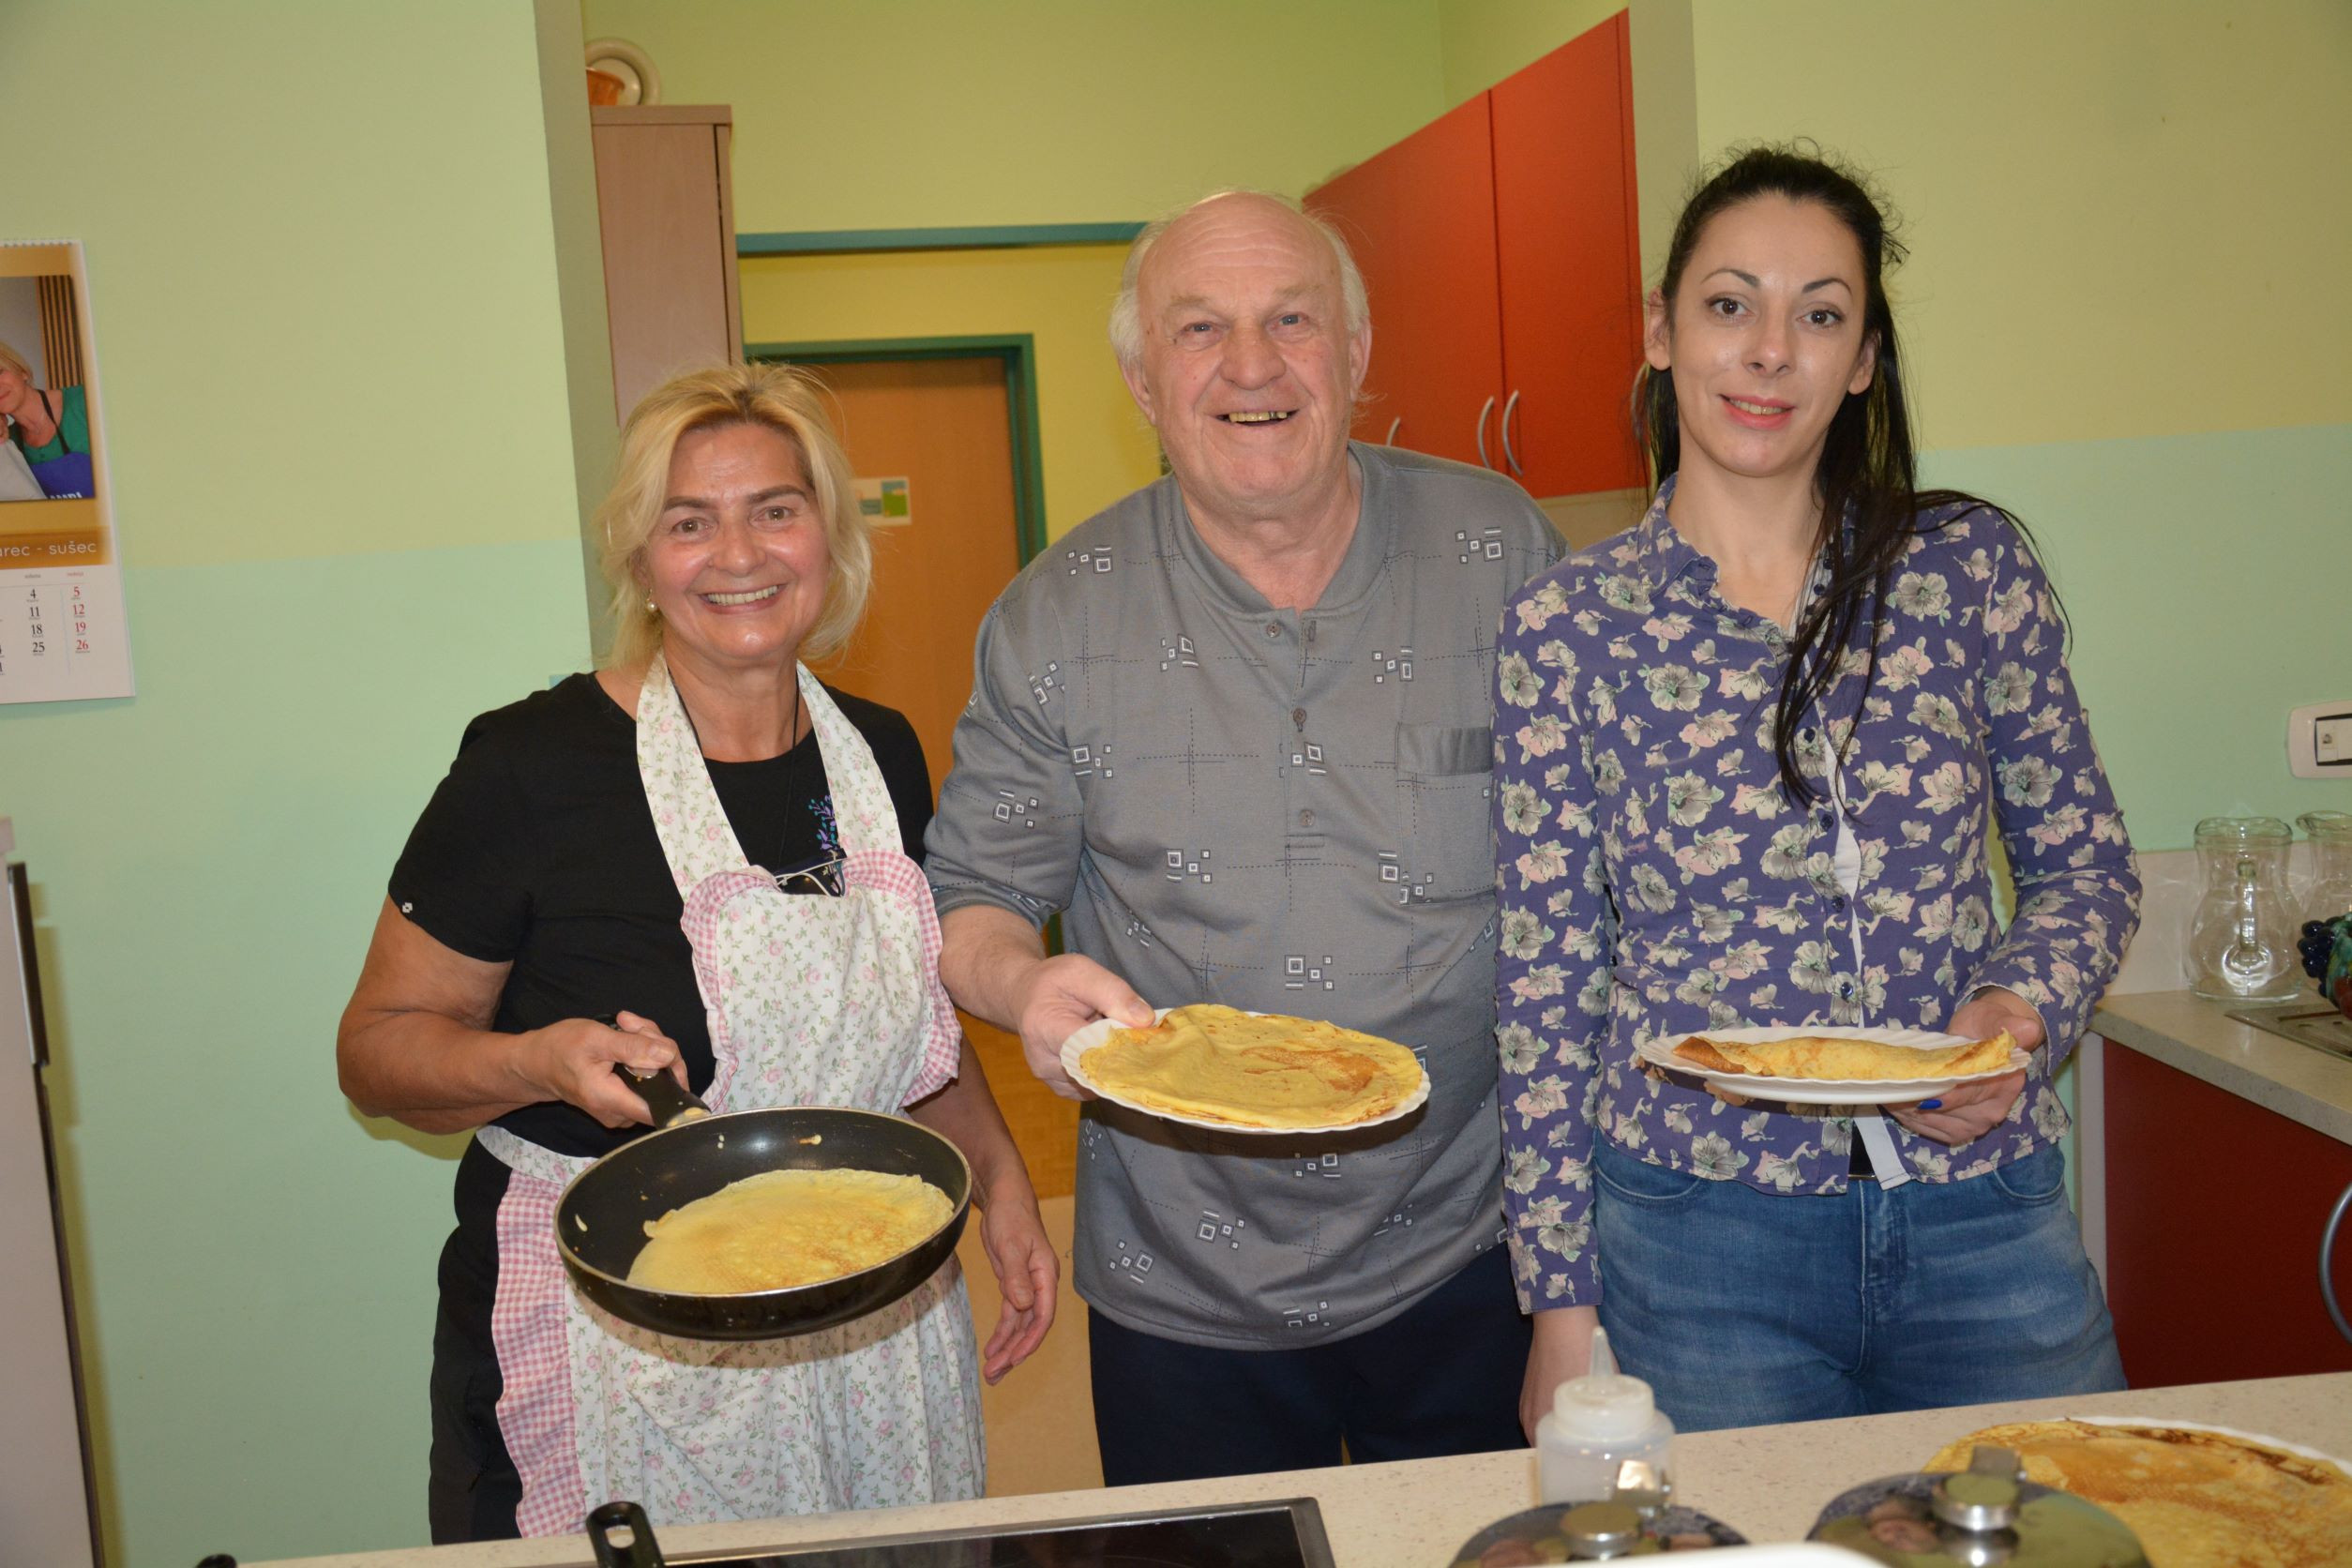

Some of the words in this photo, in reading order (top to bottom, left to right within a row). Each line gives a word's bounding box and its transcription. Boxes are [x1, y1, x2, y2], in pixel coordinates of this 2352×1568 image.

[49, 540, 97, 555] sušec
[30, 589, 38, 598] 4
[73, 586, 80, 596] 5
[30, 607, 39, 616] 11
[73, 604, 84, 614] 12
[31, 624, 42, 634] 18
[75, 622, 85, 632] 19
[33, 641, 45, 652] 25
[76, 640, 88, 649] 26
